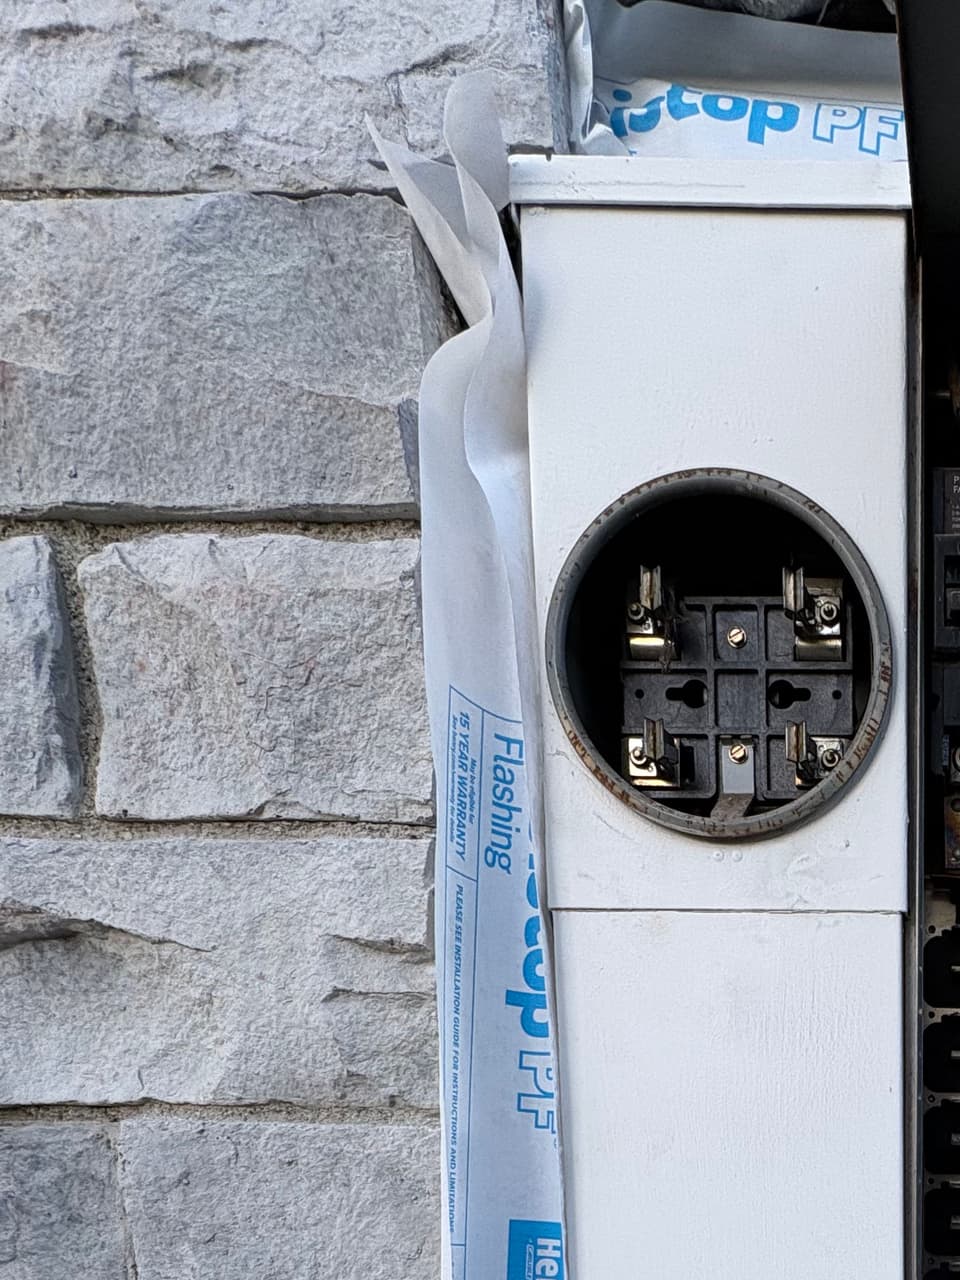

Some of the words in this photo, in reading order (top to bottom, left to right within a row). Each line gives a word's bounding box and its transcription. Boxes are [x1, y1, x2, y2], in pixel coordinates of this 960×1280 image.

[812, 102, 905, 155] PF
[459, 711, 470, 729] 15
[457, 732, 470, 773] YEAR
[455, 774, 468, 862] WARRANTY
[484, 733, 524, 875] Flashing
[455, 883, 464, 923] PLEASE
[454, 924, 463, 945] SEE
[453, 945, 463, 1017] INSTALLATION
[452, 1018, 460, 1048] GUIDE
[451, 1050, 460, 1071] FOR
[450, 1072, 459, 1148] INSTRUCTIONS
